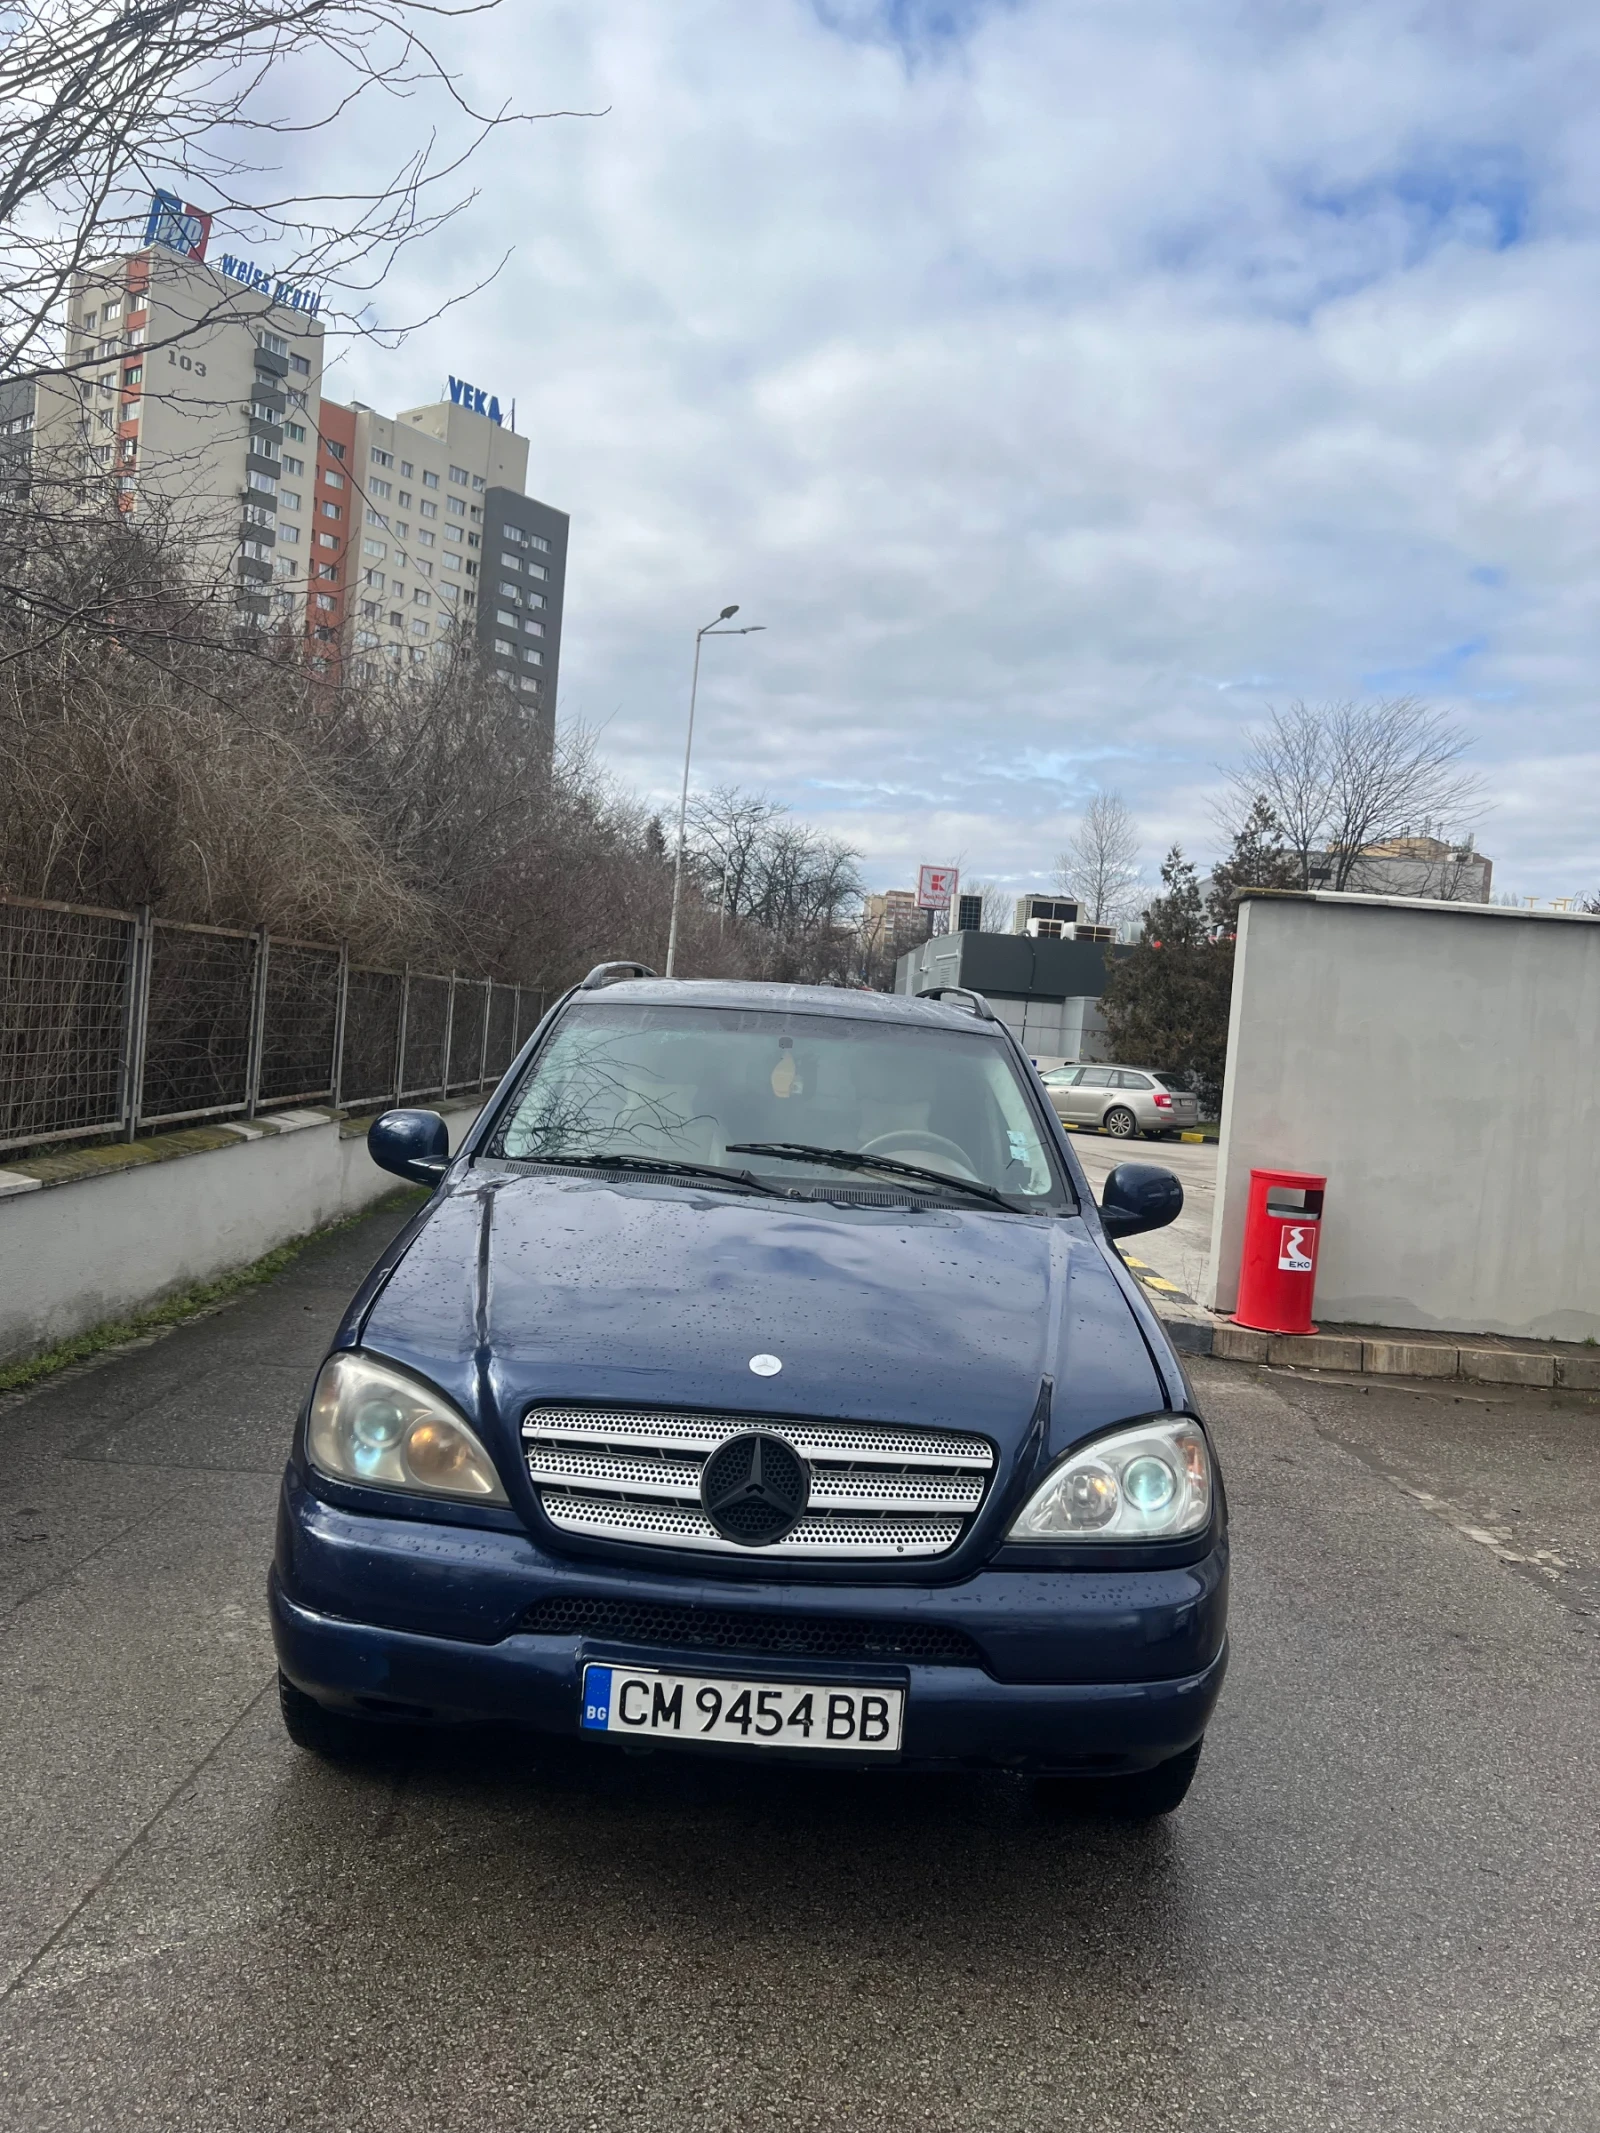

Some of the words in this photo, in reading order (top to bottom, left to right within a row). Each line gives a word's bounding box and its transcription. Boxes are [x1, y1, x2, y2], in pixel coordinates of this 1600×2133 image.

[222, 253, 271, 295] weiss
[168, 350, 207, 378] 103
[449, 375, 503, 427] VEKA
[1289, 1261, 1311, 1269] EKO
[586, 1705, 607, 1721] BG
[619, 1679, 684, 1730] CM
[696, 1686, 814, 1738] 9454
[826, 1694, 890, 1742] BB
